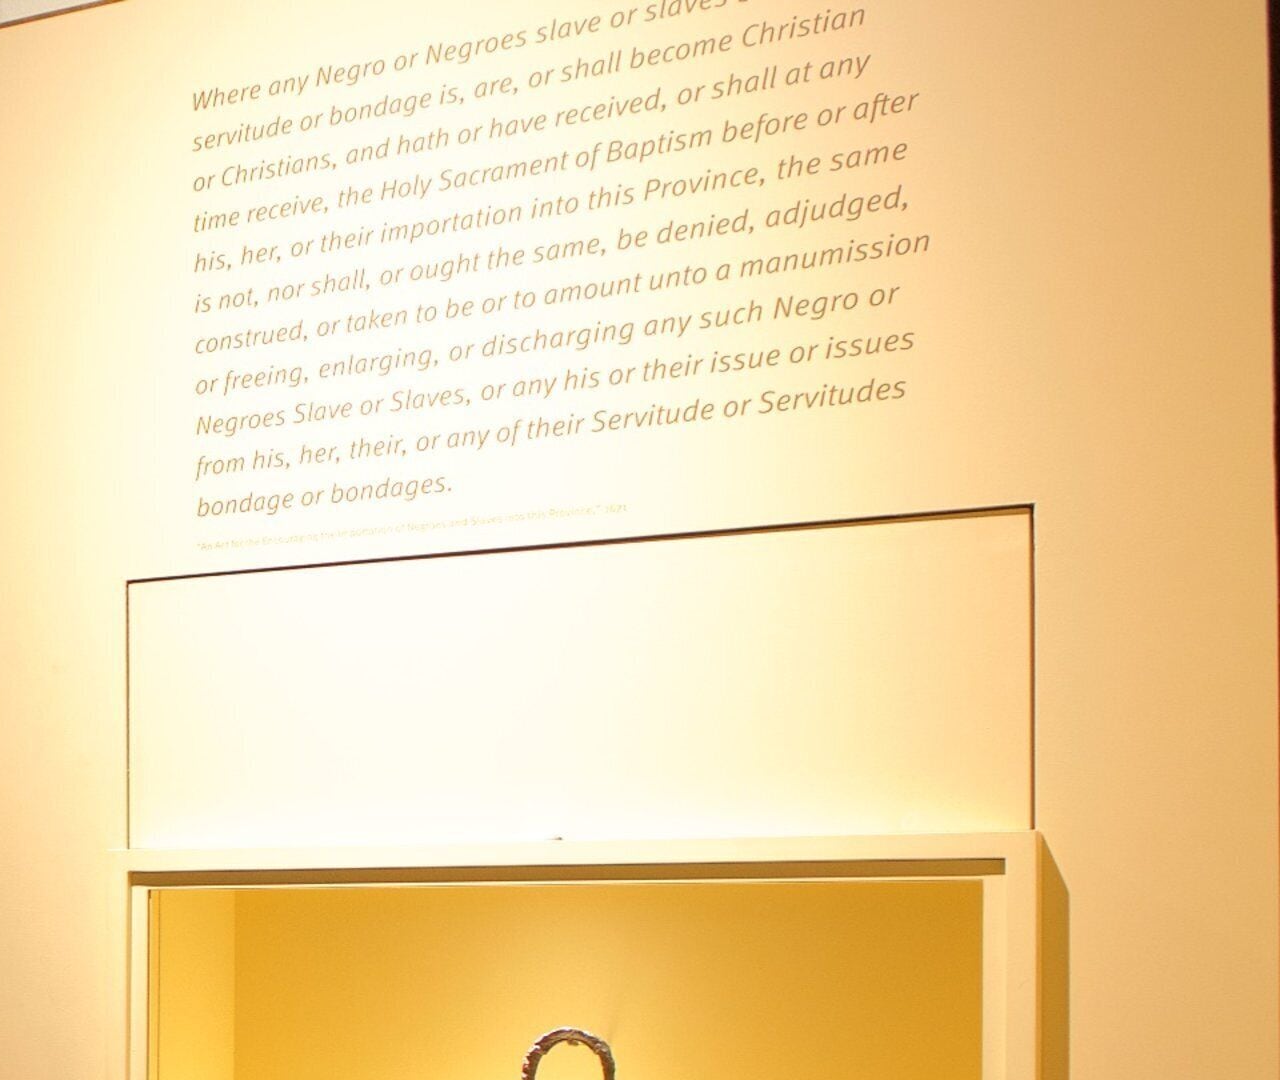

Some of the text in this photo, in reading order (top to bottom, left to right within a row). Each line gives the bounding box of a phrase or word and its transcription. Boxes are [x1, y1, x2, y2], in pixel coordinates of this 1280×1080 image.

[191, 8, 866, 153] servitude or bondage is, are, or shall become Christian
[192, 82, 262, 112] Where
[268, 73, 310, 97] any
[315, 59, 386, 88] Negro
[393, 51, 419, 72] or
[424, 29, 527, 66] Negroes
[534, 15, 602, 44] slave
[609, 7, 639, 29] or
[192, 54, 872, 193] or Christians, and hath or have received, or shall at any
[193, 91, 920, 233] time receive, the Holy Sacrament of Baptism before or after
[193, 142, 908, 274] his, her, or their importation into this Province, the same
[194, 183, 908, 314] is not, nor shall, or ought the same, be denied, adjudged,
[194, 232, 930, 355] construed, or taken to be or to amount unto a manumission
[194, 377, 907, 482] from his, her, their, or any of their Servitude or Servitudes
[195, 331, 915, 438] Negroes Slave or Slaves, or any his or their issue or issues
